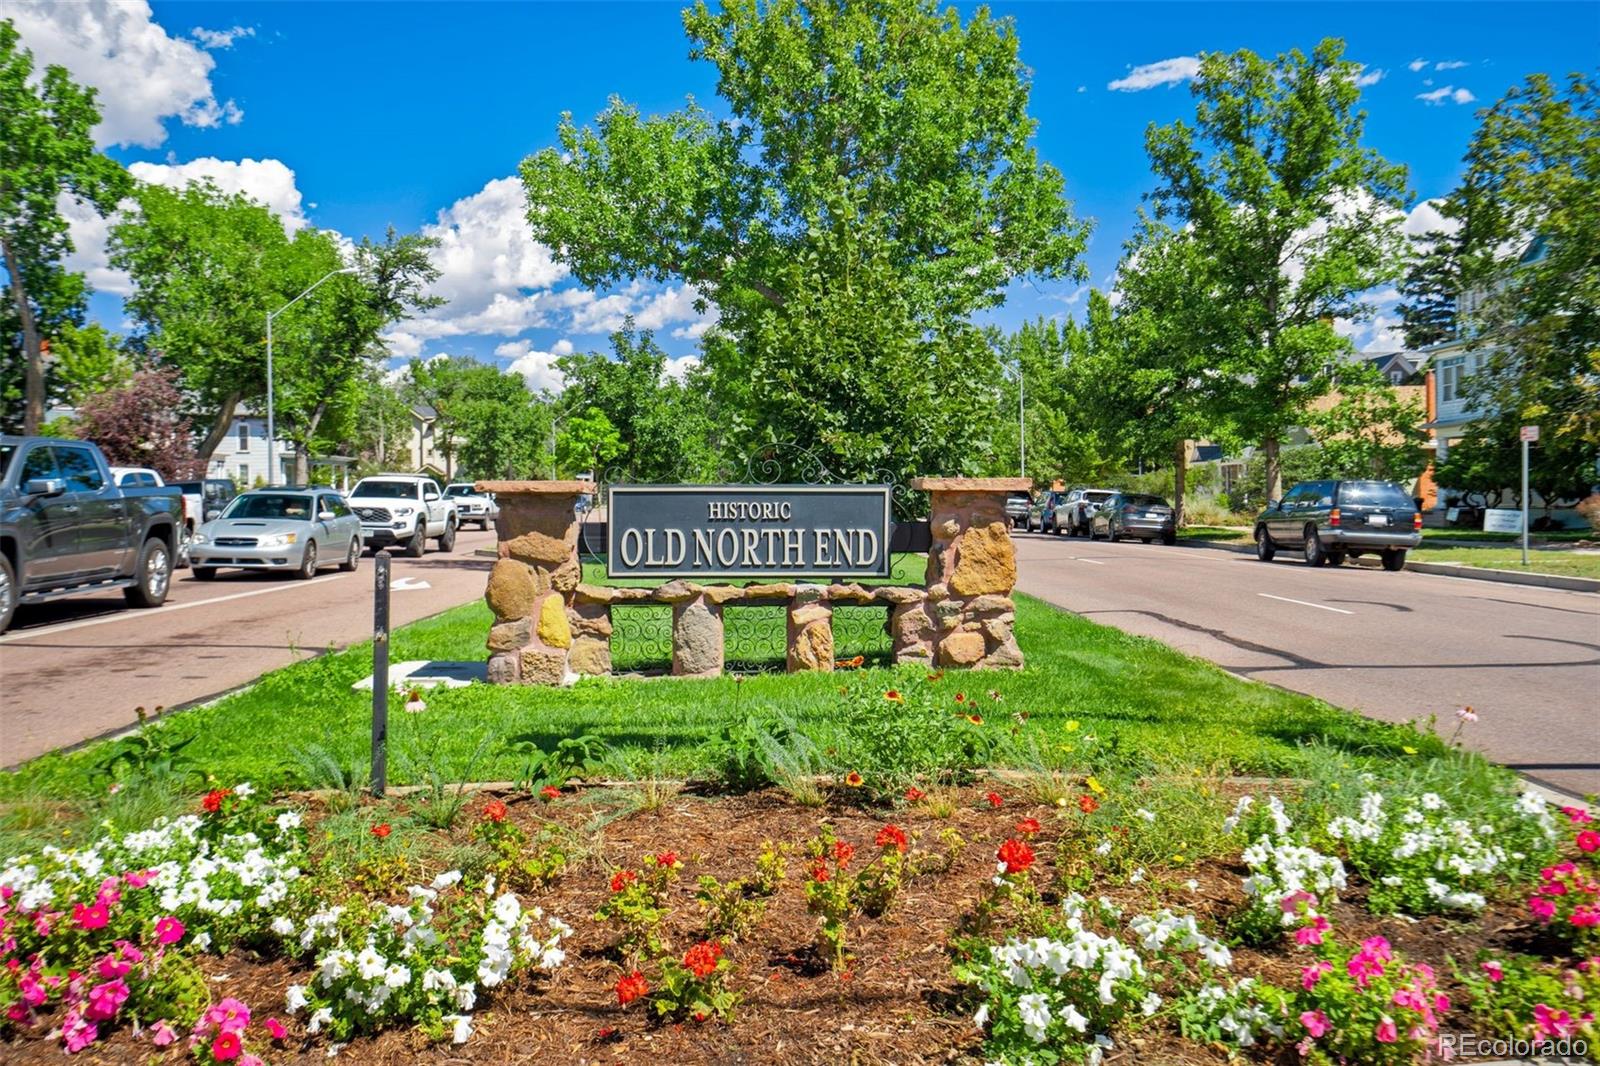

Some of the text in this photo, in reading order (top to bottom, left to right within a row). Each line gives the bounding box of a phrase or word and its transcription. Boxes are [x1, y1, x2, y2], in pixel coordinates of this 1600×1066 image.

[708, 502, 792, 520] HISTORIC
[620, 528, 879, 567] OLD NORTH END
